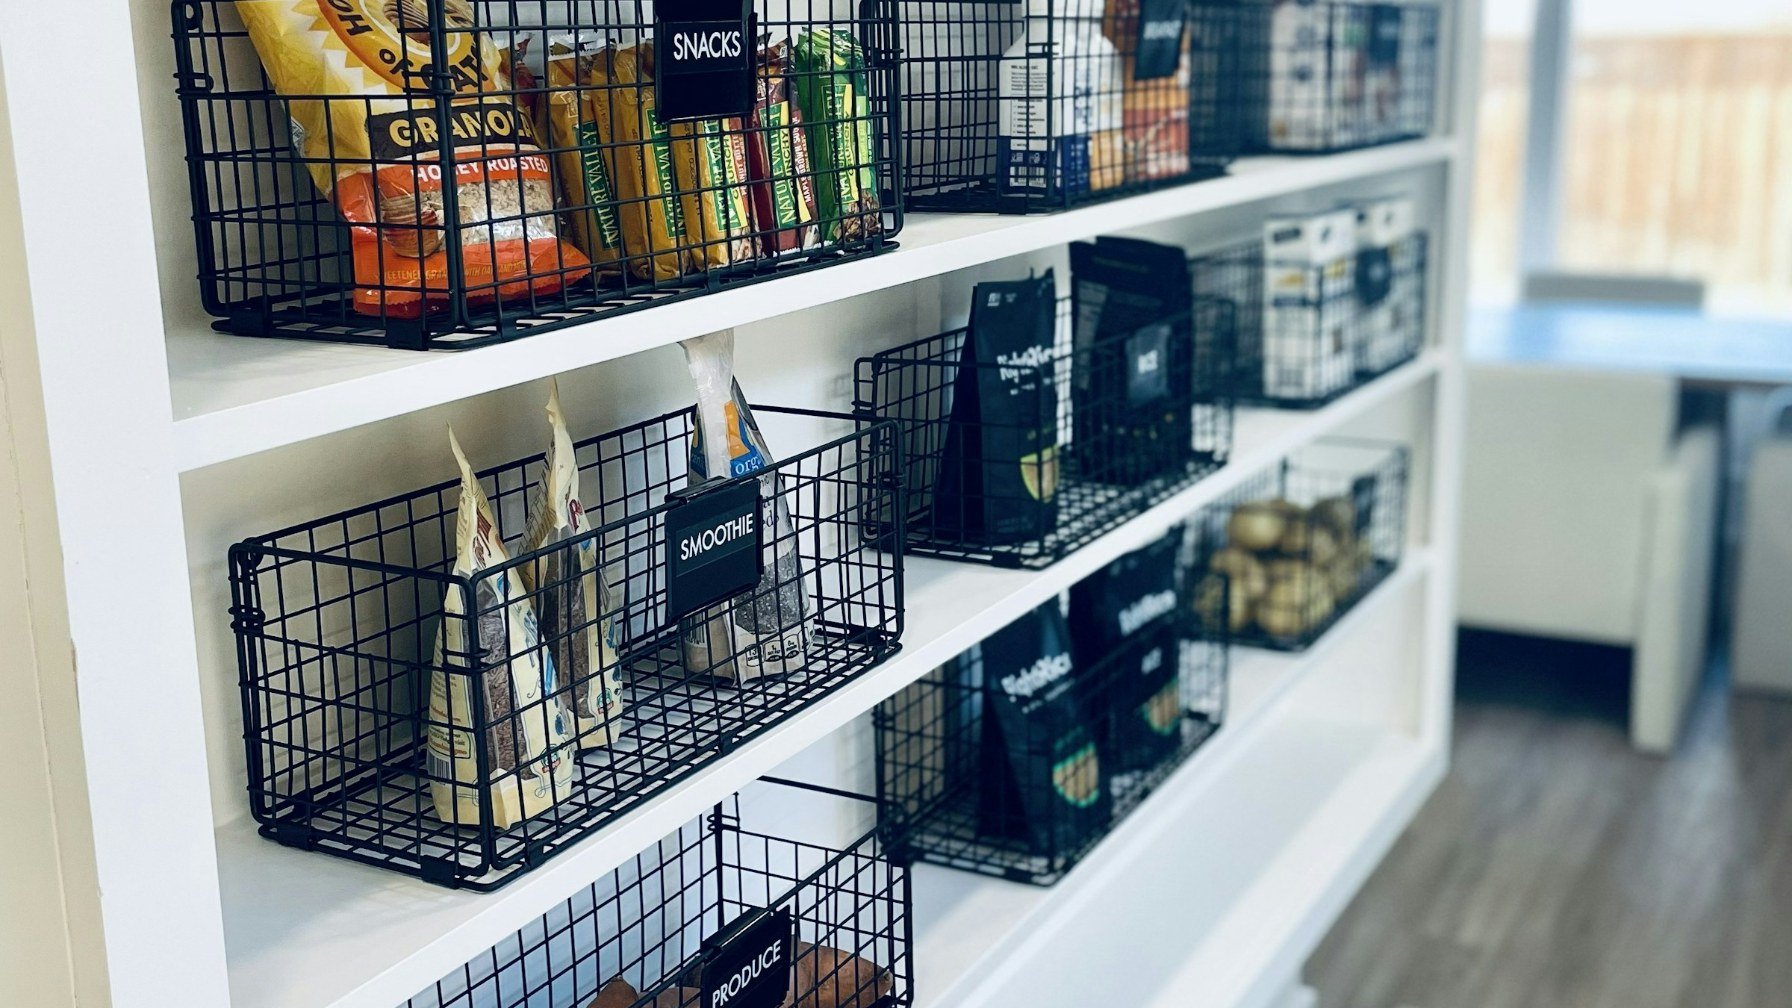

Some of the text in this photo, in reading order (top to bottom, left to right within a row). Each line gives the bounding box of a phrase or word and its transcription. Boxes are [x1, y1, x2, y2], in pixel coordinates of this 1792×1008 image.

[673, 30, 741, 60] SNACKS
[411, 156, 549, 183] HOEY ROASTED
[681, 513, 753, 560] SMOOTHIE
[712, 939, 781, 1008] PRODUCE
